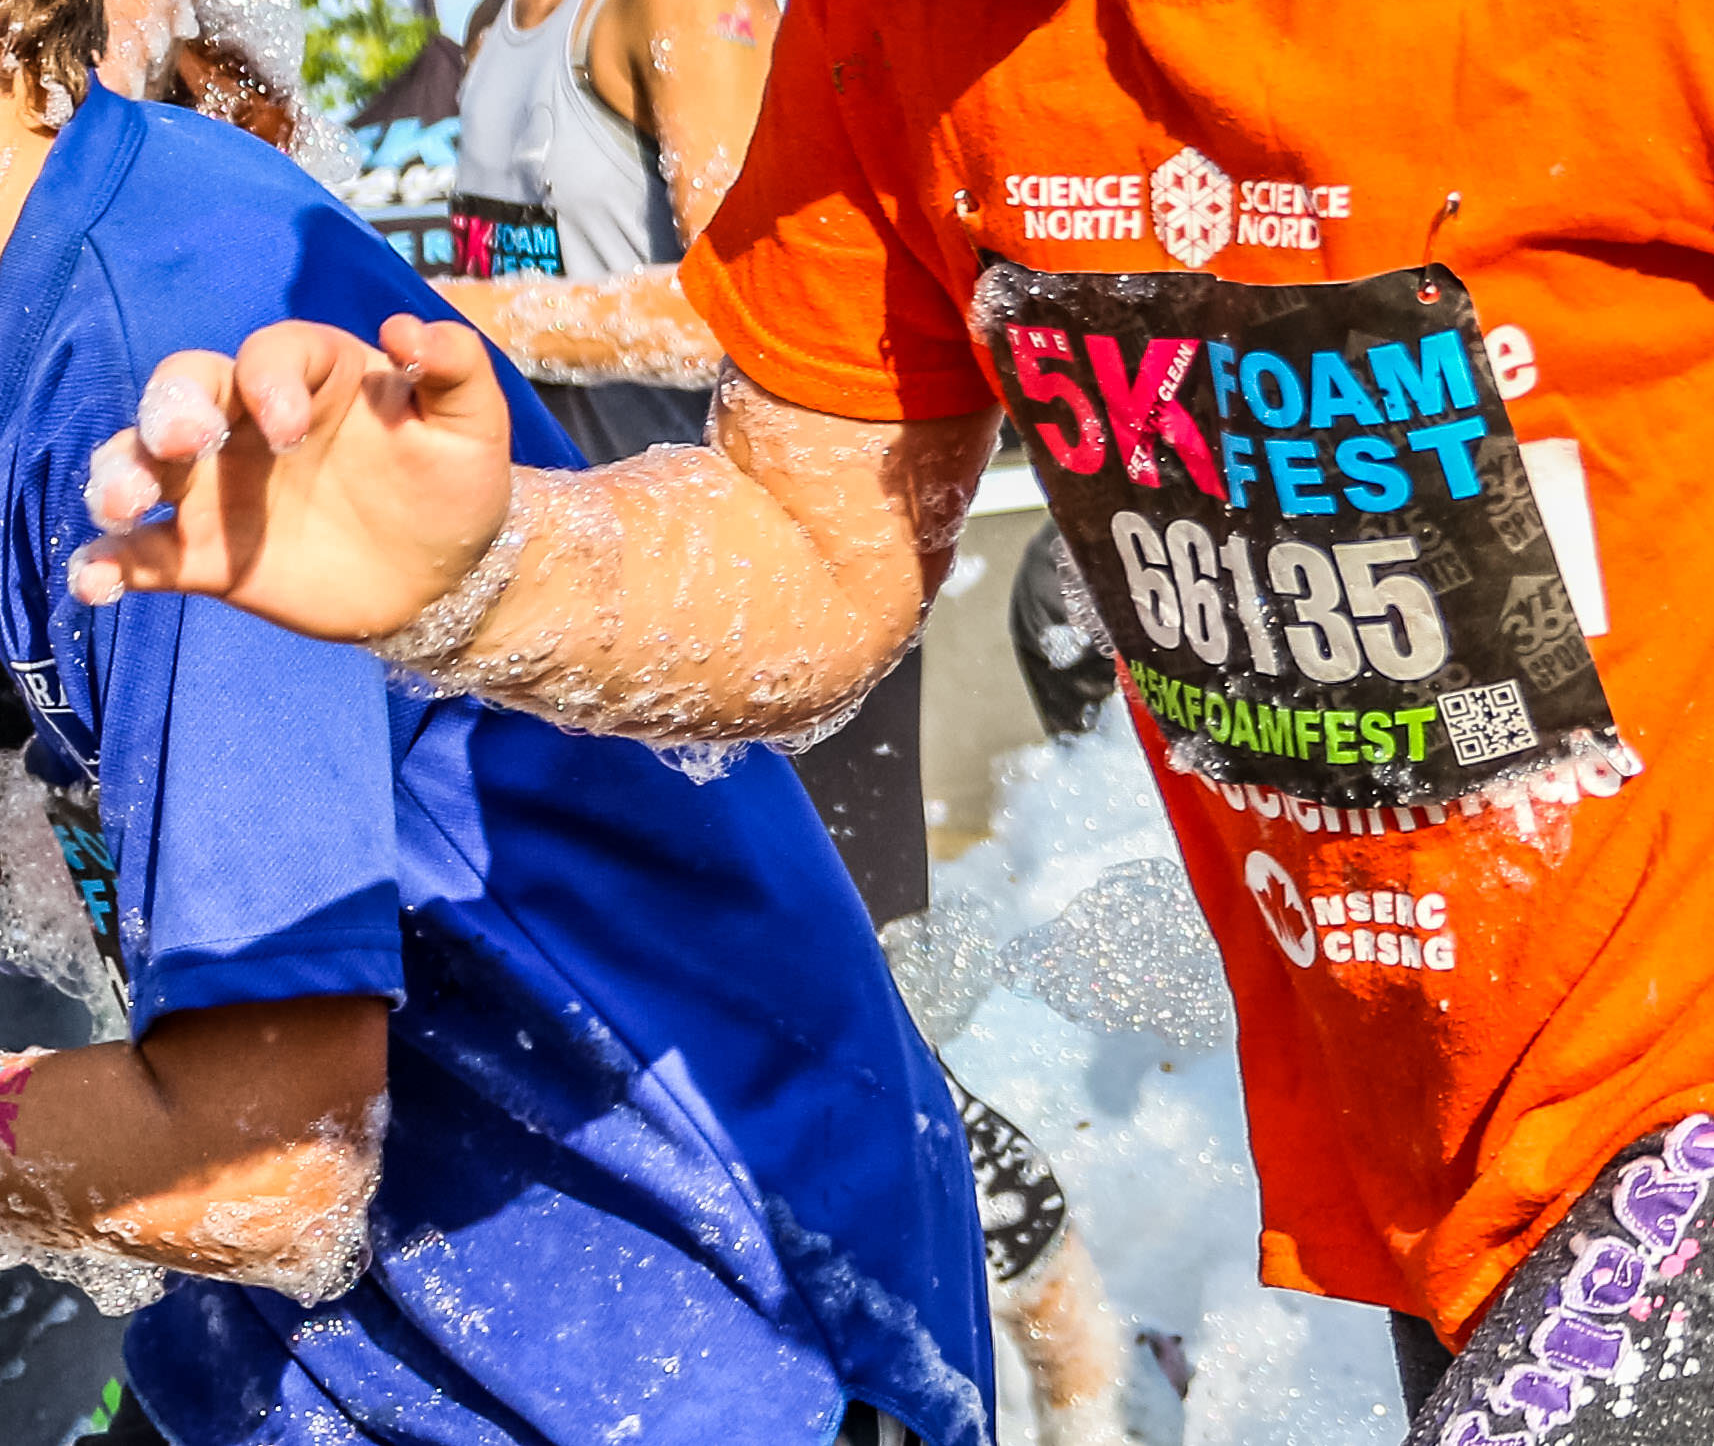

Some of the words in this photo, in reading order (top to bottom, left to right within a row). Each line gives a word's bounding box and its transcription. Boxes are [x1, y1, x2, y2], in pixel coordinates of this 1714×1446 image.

[1005, 175, 1142, 208] SCIENCE
[1240, 181, 1351, 219] SCIENCE
[1023, 210, 1142, 241] NORTH
[1236, 216, 1322, 251] NORD
[1008, 328, 1068, 352] THE
[1205, 328, 1479, 430] FOAM
[1004, 322, 1230, 502] 5K
[1220, 415, 1487, 516] FEST
[1110, 510, 1450, 684] 66135
[1129, 658, 1438, 766] #5KFOAMFEST
[1311, 891, 1447, 931] NSERC
[1323, 928, 1456, 972] CRSNG
